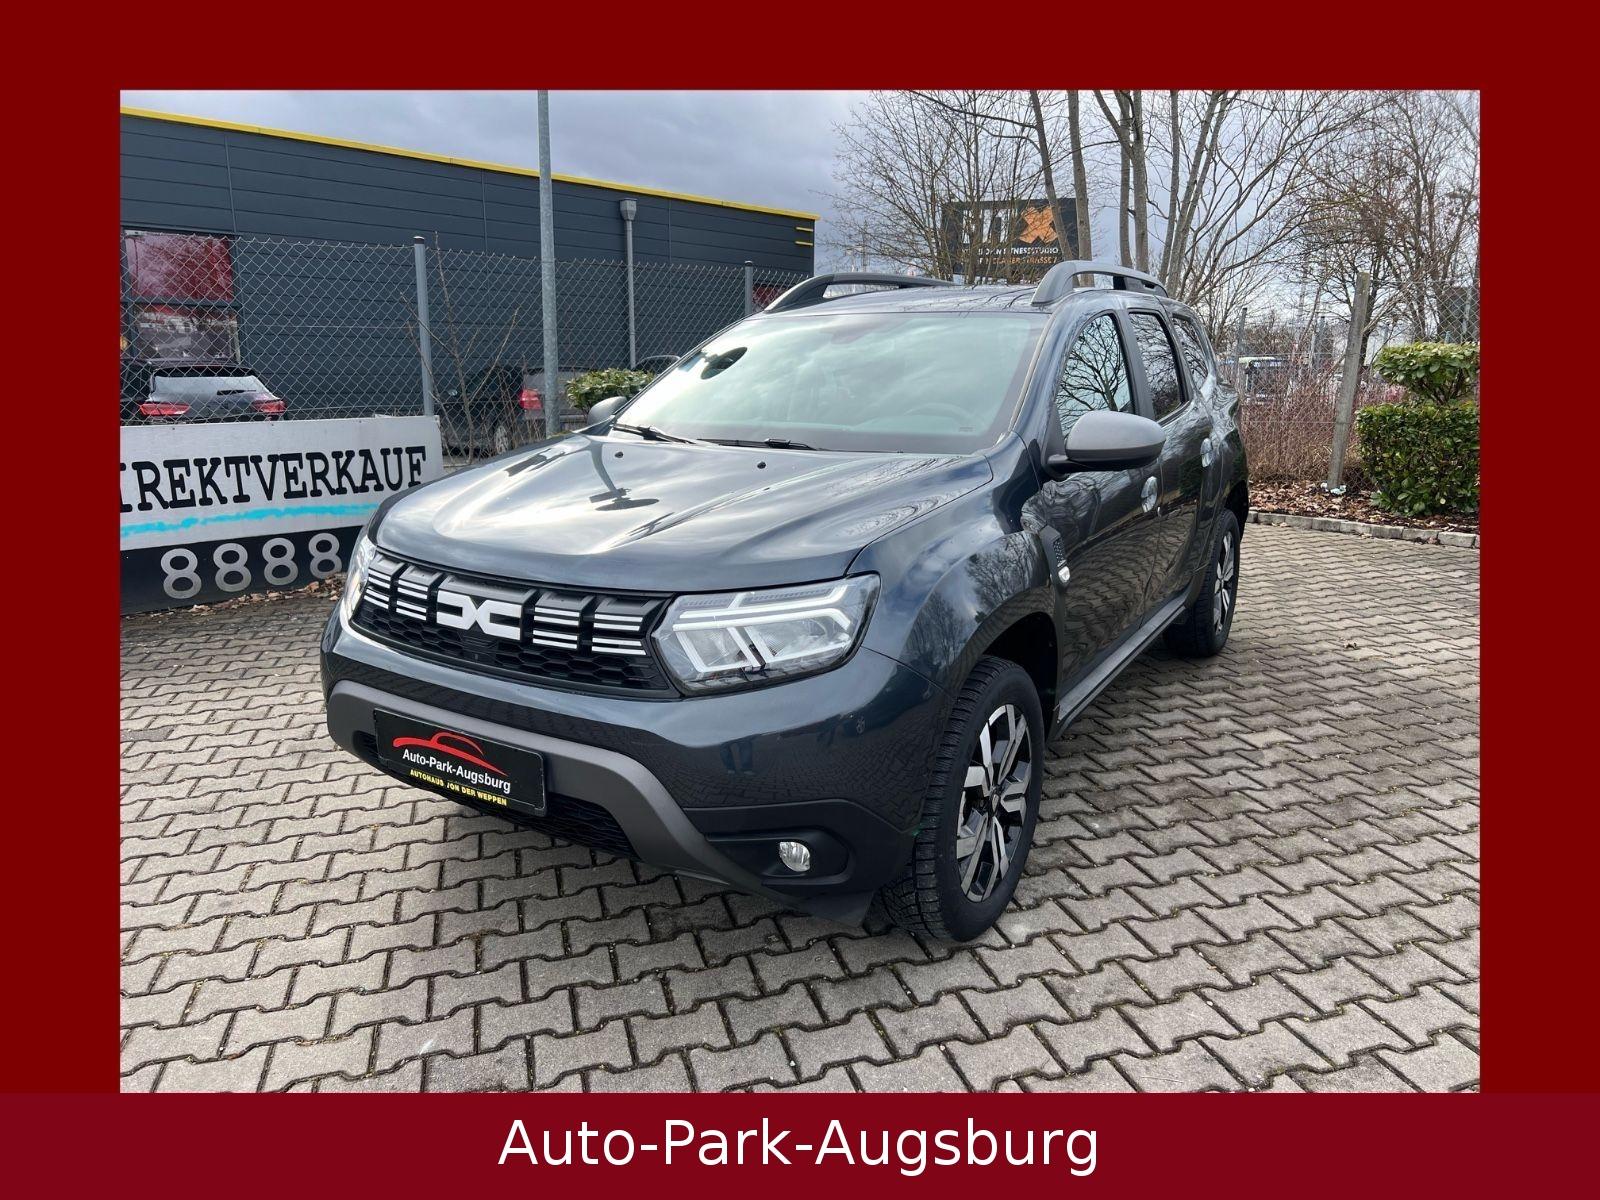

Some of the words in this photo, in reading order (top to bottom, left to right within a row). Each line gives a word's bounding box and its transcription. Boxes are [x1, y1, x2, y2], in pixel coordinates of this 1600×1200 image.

[160, 533, 342, 599] 8888
[402, 748, 511, 794] Auto-Park-Augsburg
[410, 769, 444, 787] AUTOHAUS
[461, 786, 476, 797] DER
[477, 791, 507, 806] WEPPEN
